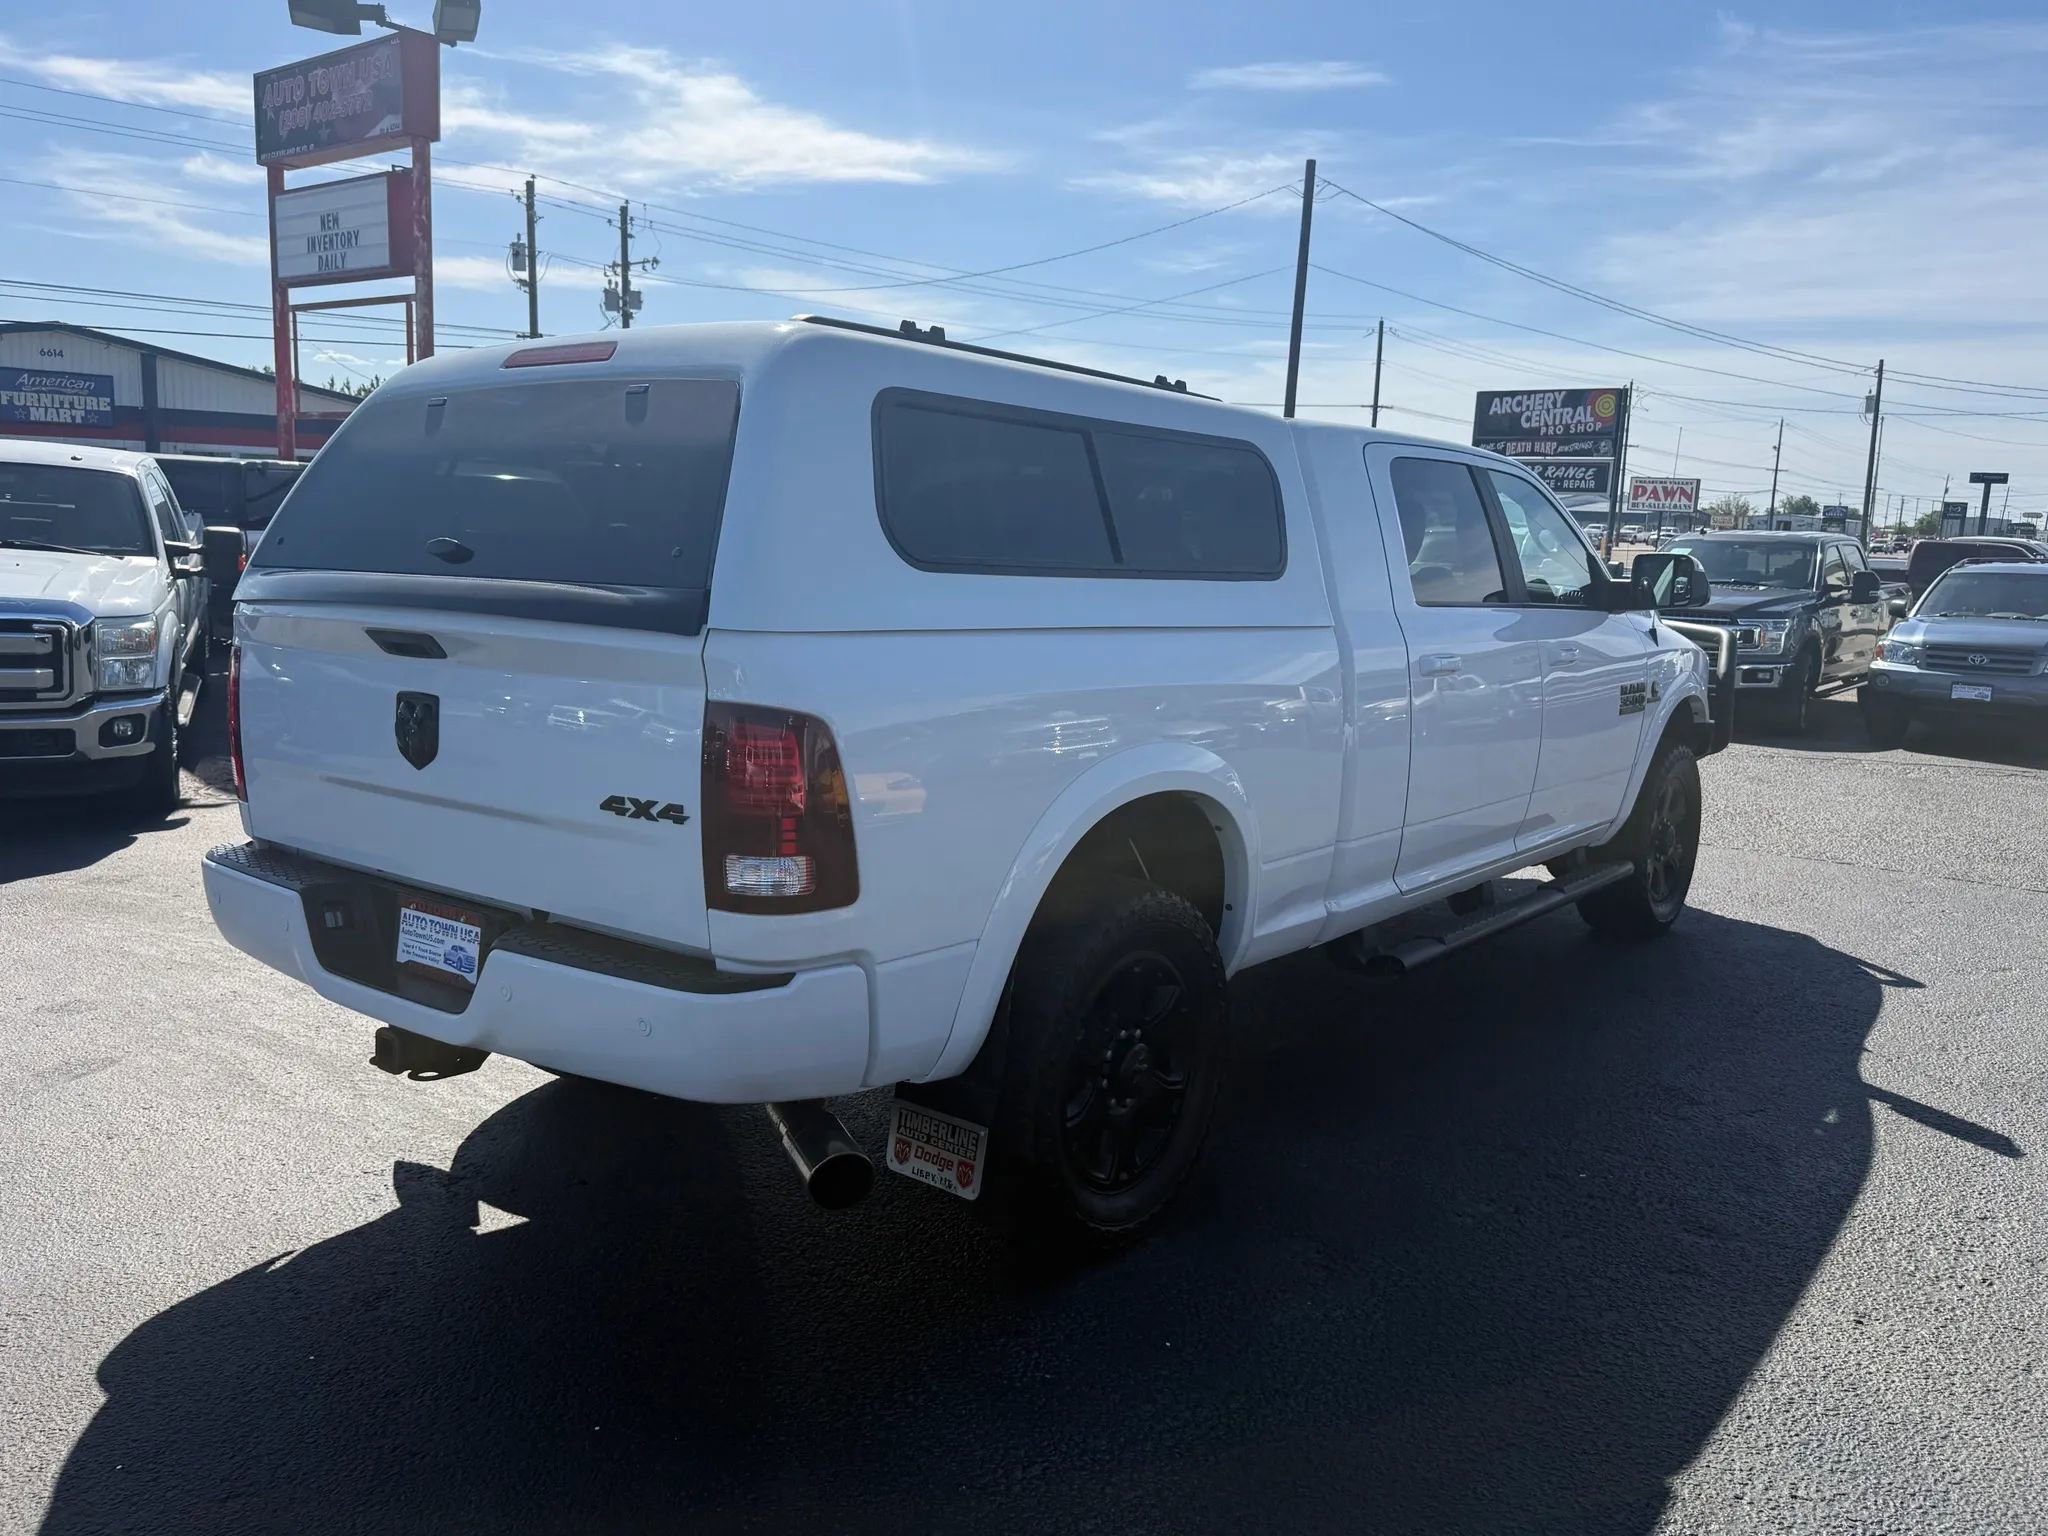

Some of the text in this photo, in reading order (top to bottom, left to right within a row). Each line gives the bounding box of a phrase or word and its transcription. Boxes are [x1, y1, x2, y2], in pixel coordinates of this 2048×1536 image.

[262, 51, 394, 109] AUTO TOWN USA
[320, 212, 340, 232] NEW
[307, 230, 360, 254] INVENTORY
[318, 252, 347, 272] DAILY
[39, 348, 64, 359] 6614
[15, 373, 95, 390] American
[0, 391, 112, 412] FURNITURE
[1489, 391, 1567, 415] ARCHERY
[29, 407, 85, 424] MART
[1520, 405, 1595, 429] CENTRAL
[1540, 421, 1602, 436] PRO SHOP
[1506, 441, 1533, 456] DEATH
[1534, 441, 1557, 456] HARP
[1544, 465, 1598, 480] RANGE
[1563, 480, 1595, 489] REPAIR
[1631, 484, 1694, 503] PAWN
[1620, 682, 1646, 696] RAM
[600, 794, 691, 825] 4X4
[401, 912, 480, 945] AUTO TOWN USA
[899, 1109, 979, 1151] TIMBERLINE
[898, 1126, 976, 1161] AUTO CENTER
[914, 1145, 954, 1172] Dodge
